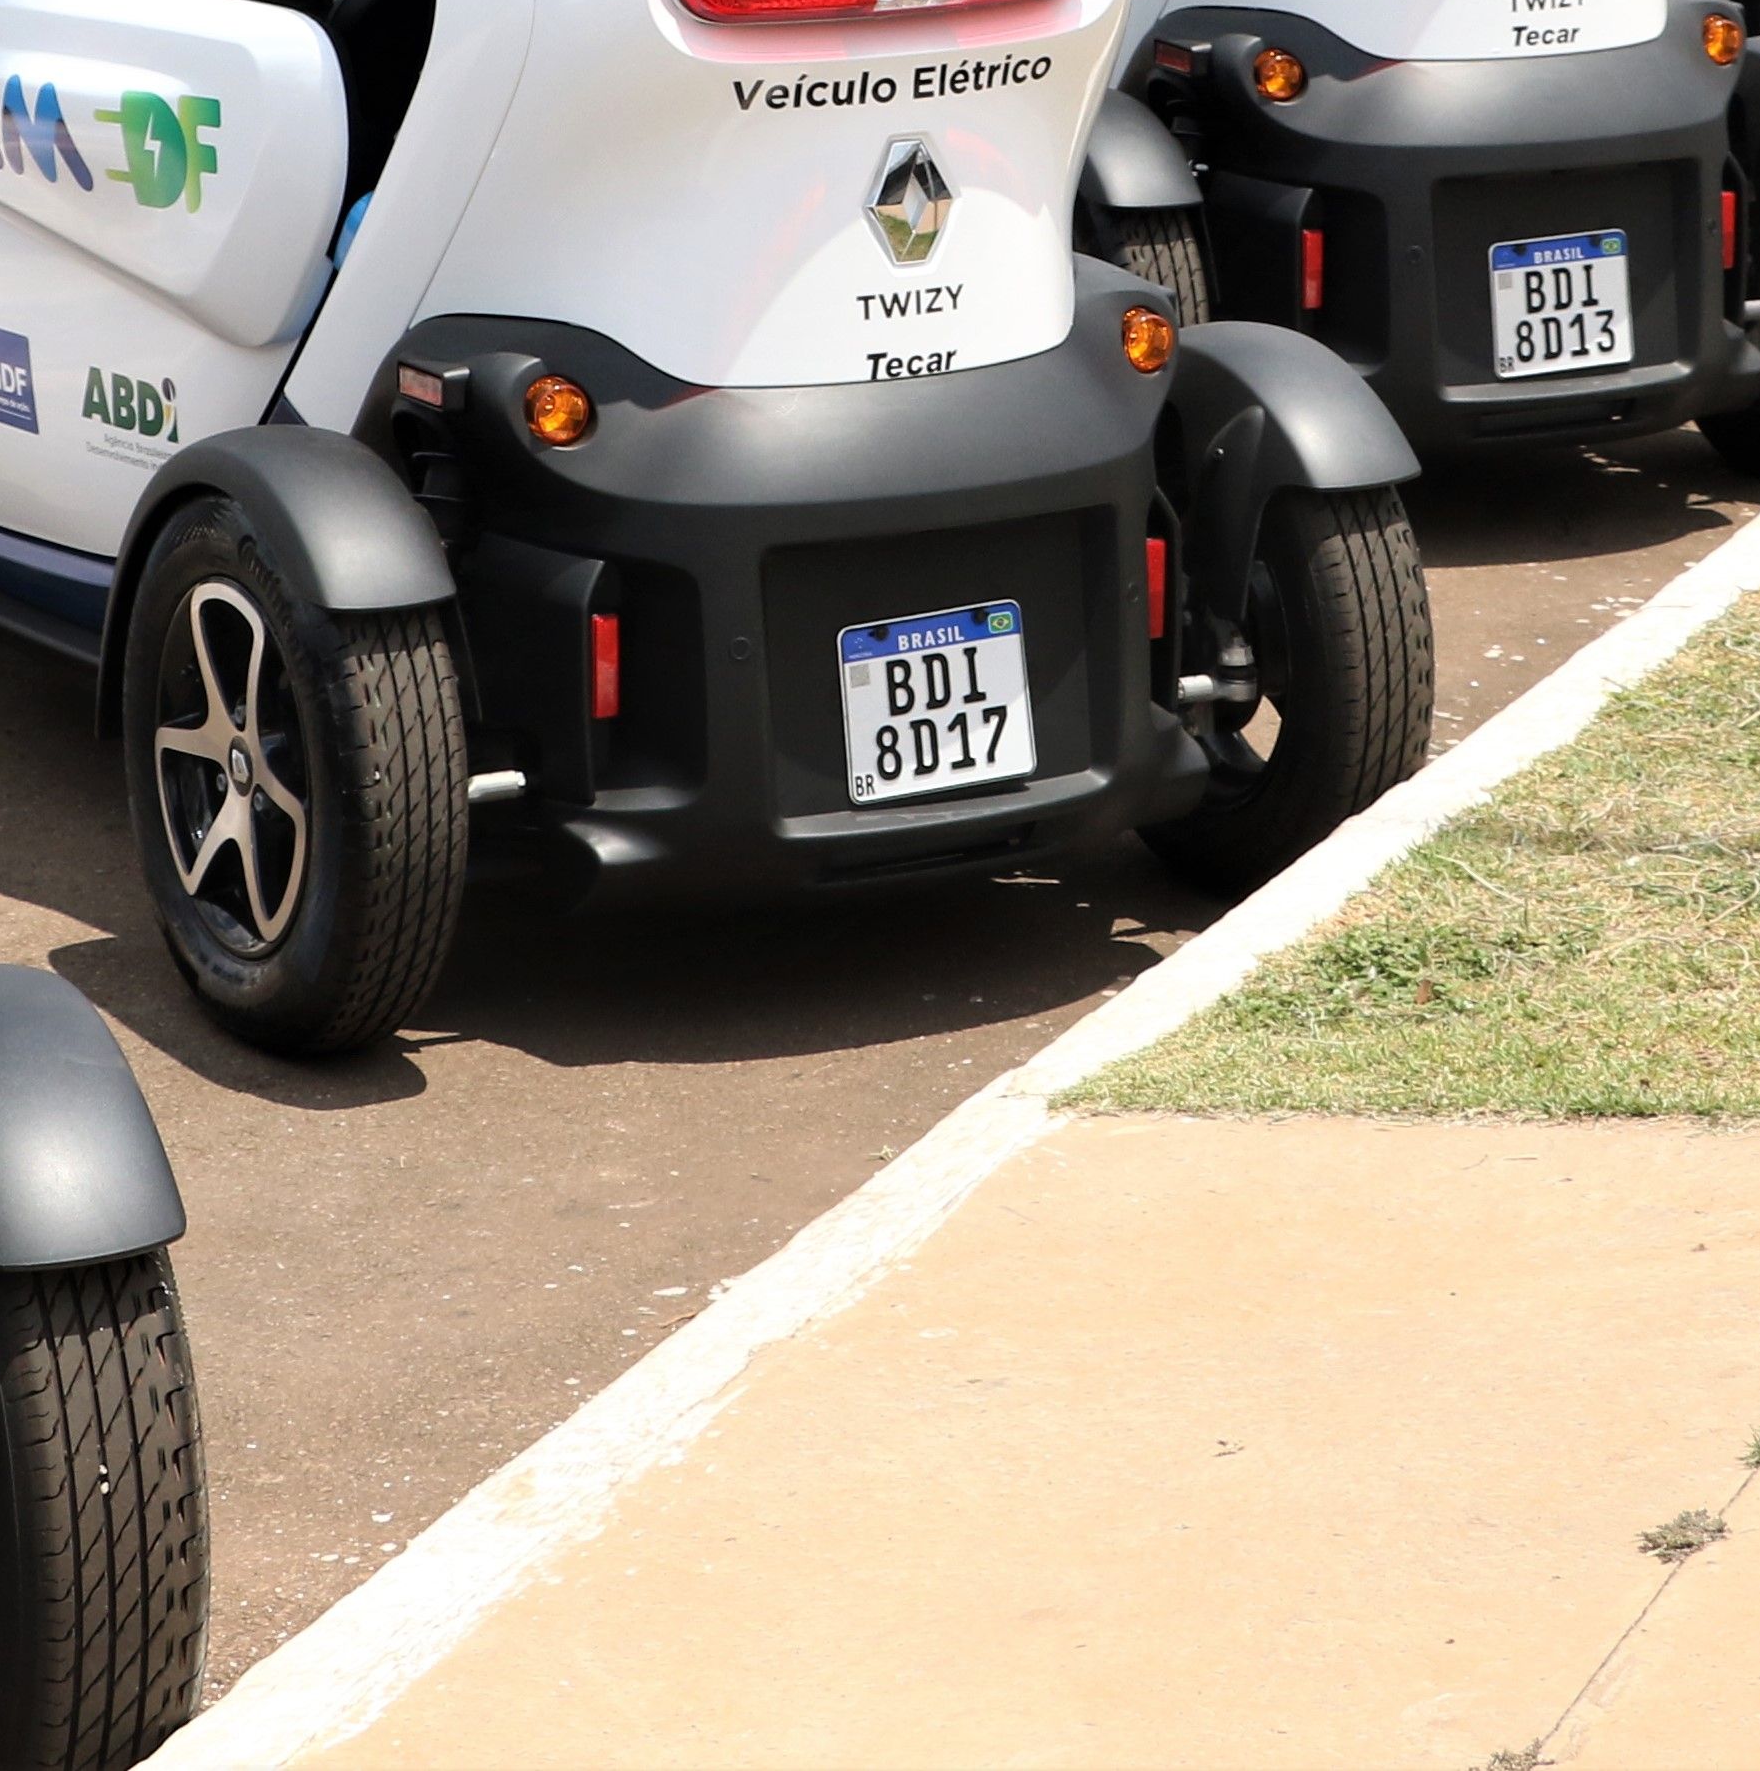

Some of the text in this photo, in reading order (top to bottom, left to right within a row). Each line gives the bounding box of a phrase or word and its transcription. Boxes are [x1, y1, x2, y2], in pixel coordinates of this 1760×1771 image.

[1512, 25, 1580, 47] Tecar
[733, 54, 1052, 111] Veículo Elétrico
[1533, 247, 1585, 264] BRASIL
[856, 283, 964, 321] TWIZY
[1525, 264, 1599, 314] BDI
[1516, 309, 1615, 362] 8D13
[867, 350, 958, 379] Tecar
[898, 626, 965, 651] BRASIL
[886, 647, 987, 716] BDI
[876, 706, 1008, 781] 8D17
[855, 774, 876, 797] BR
